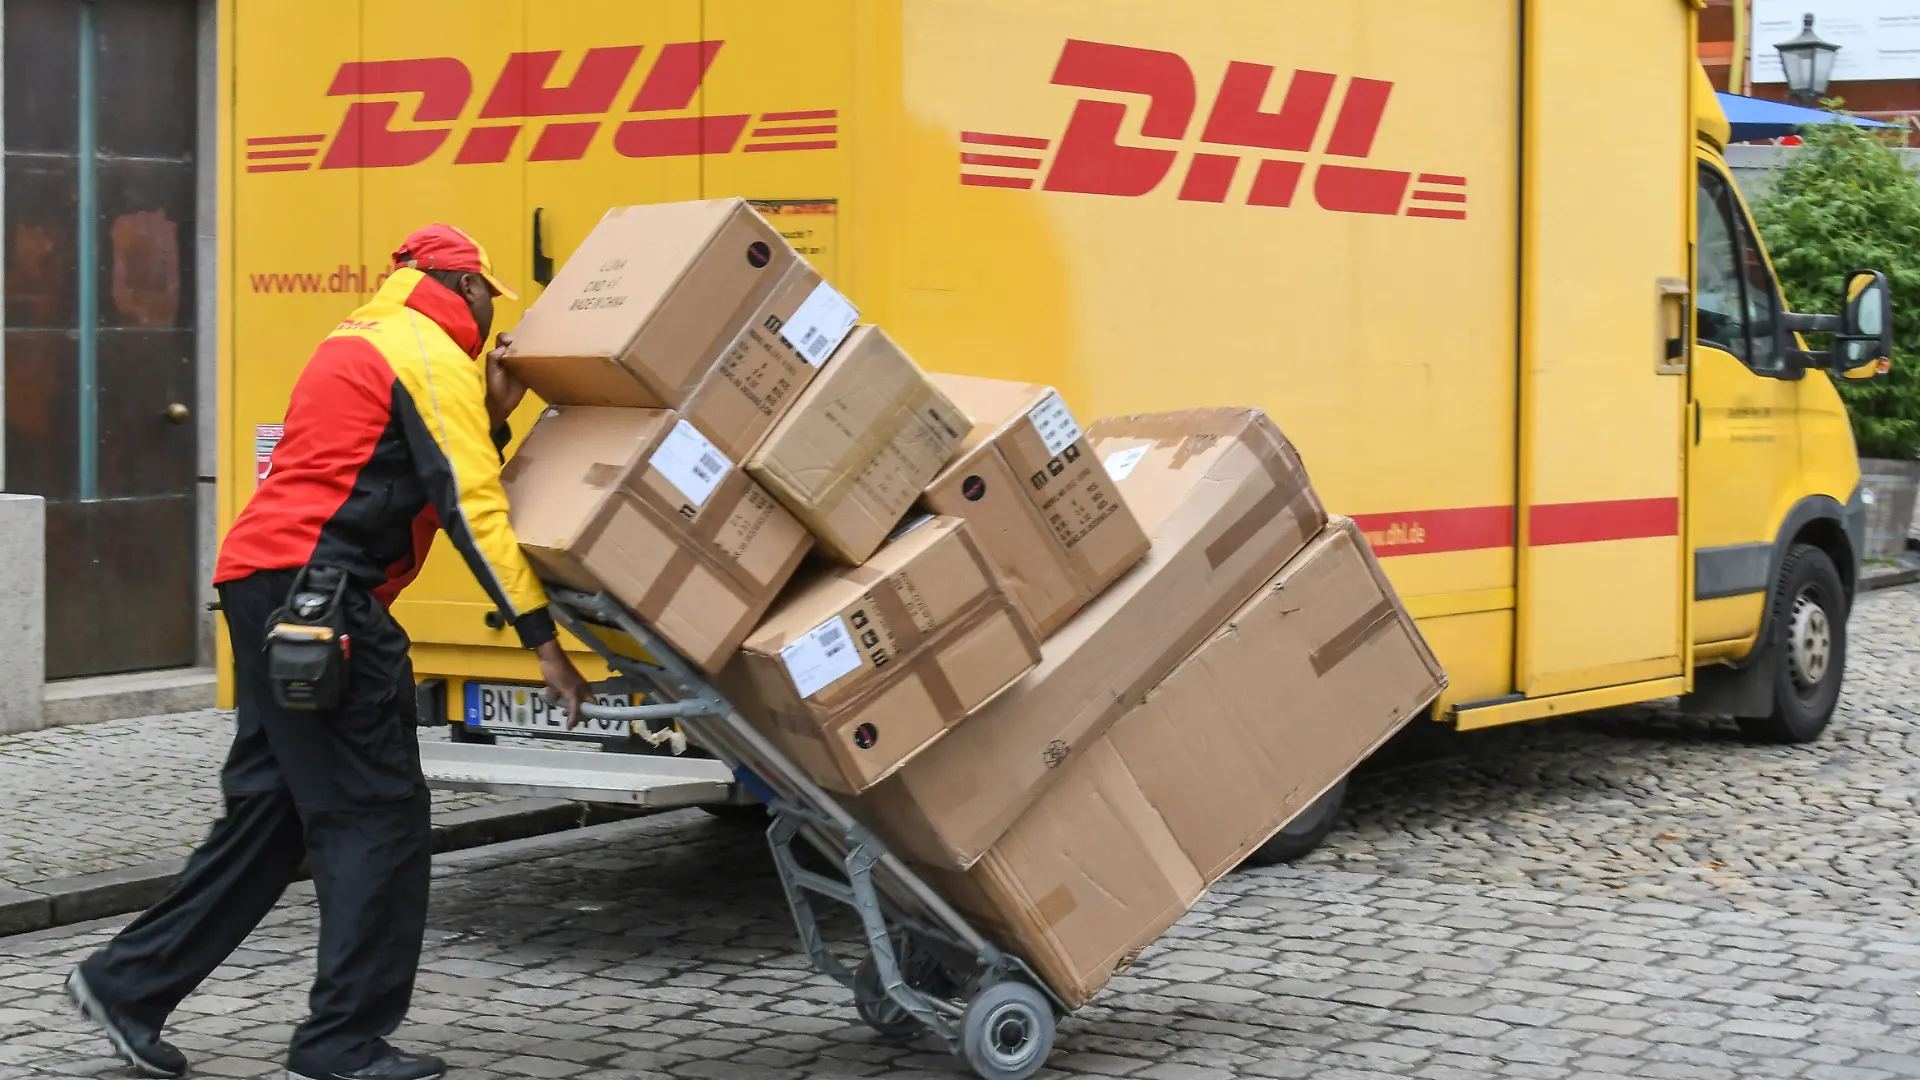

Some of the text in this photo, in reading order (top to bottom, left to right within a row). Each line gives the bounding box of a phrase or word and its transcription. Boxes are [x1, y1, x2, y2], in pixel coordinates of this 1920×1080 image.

[318, 39, 752, 170] DHL
[1040, 37, 1413, 217] DHL
[250, 264, 393, 294] www.dhl.d
[1363, 520, 1426, 547] w.dhl.de
[482, 688, 513, 723] BN
